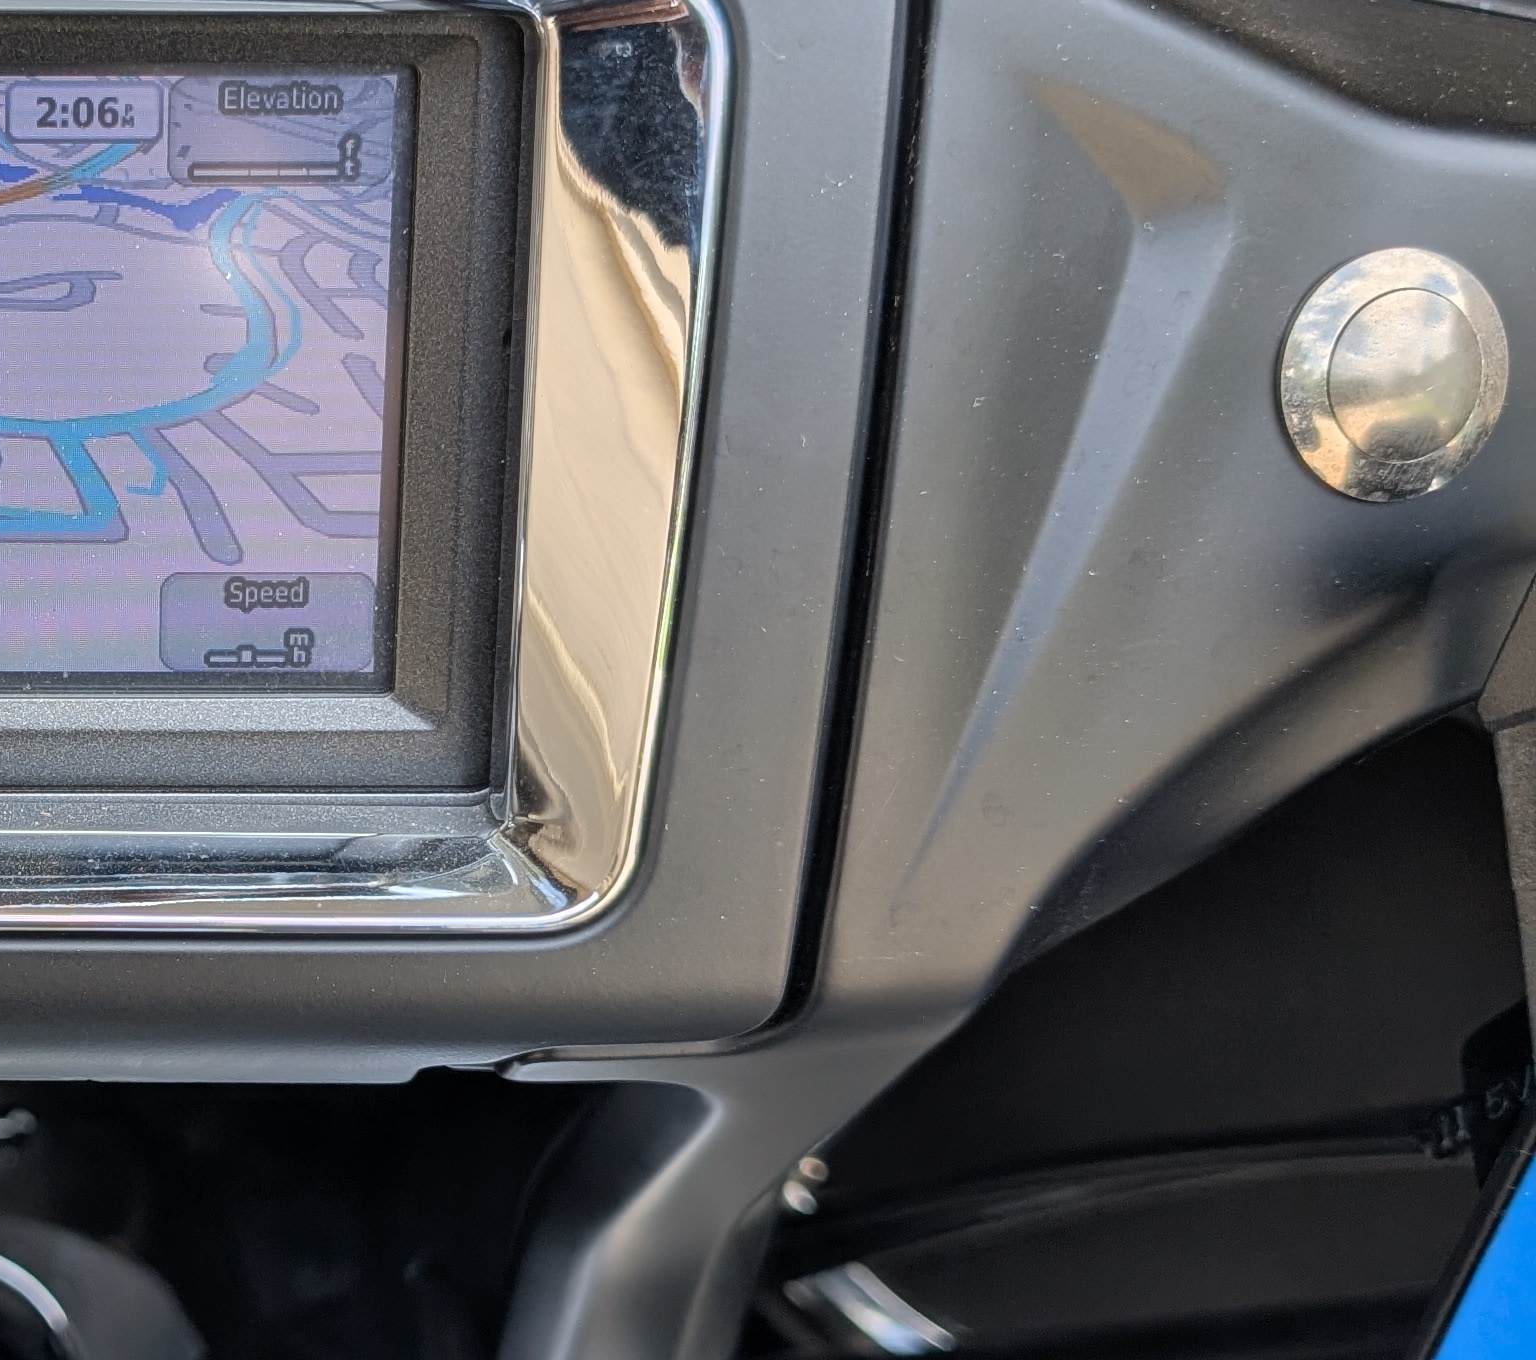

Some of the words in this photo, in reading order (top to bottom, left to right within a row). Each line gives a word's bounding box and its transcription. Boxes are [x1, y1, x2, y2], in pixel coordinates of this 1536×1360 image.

[35, 96, 120, 129] 2:06
[222, 85, 339, 111] Elevation
[228, 580, 306, 609] Speed
